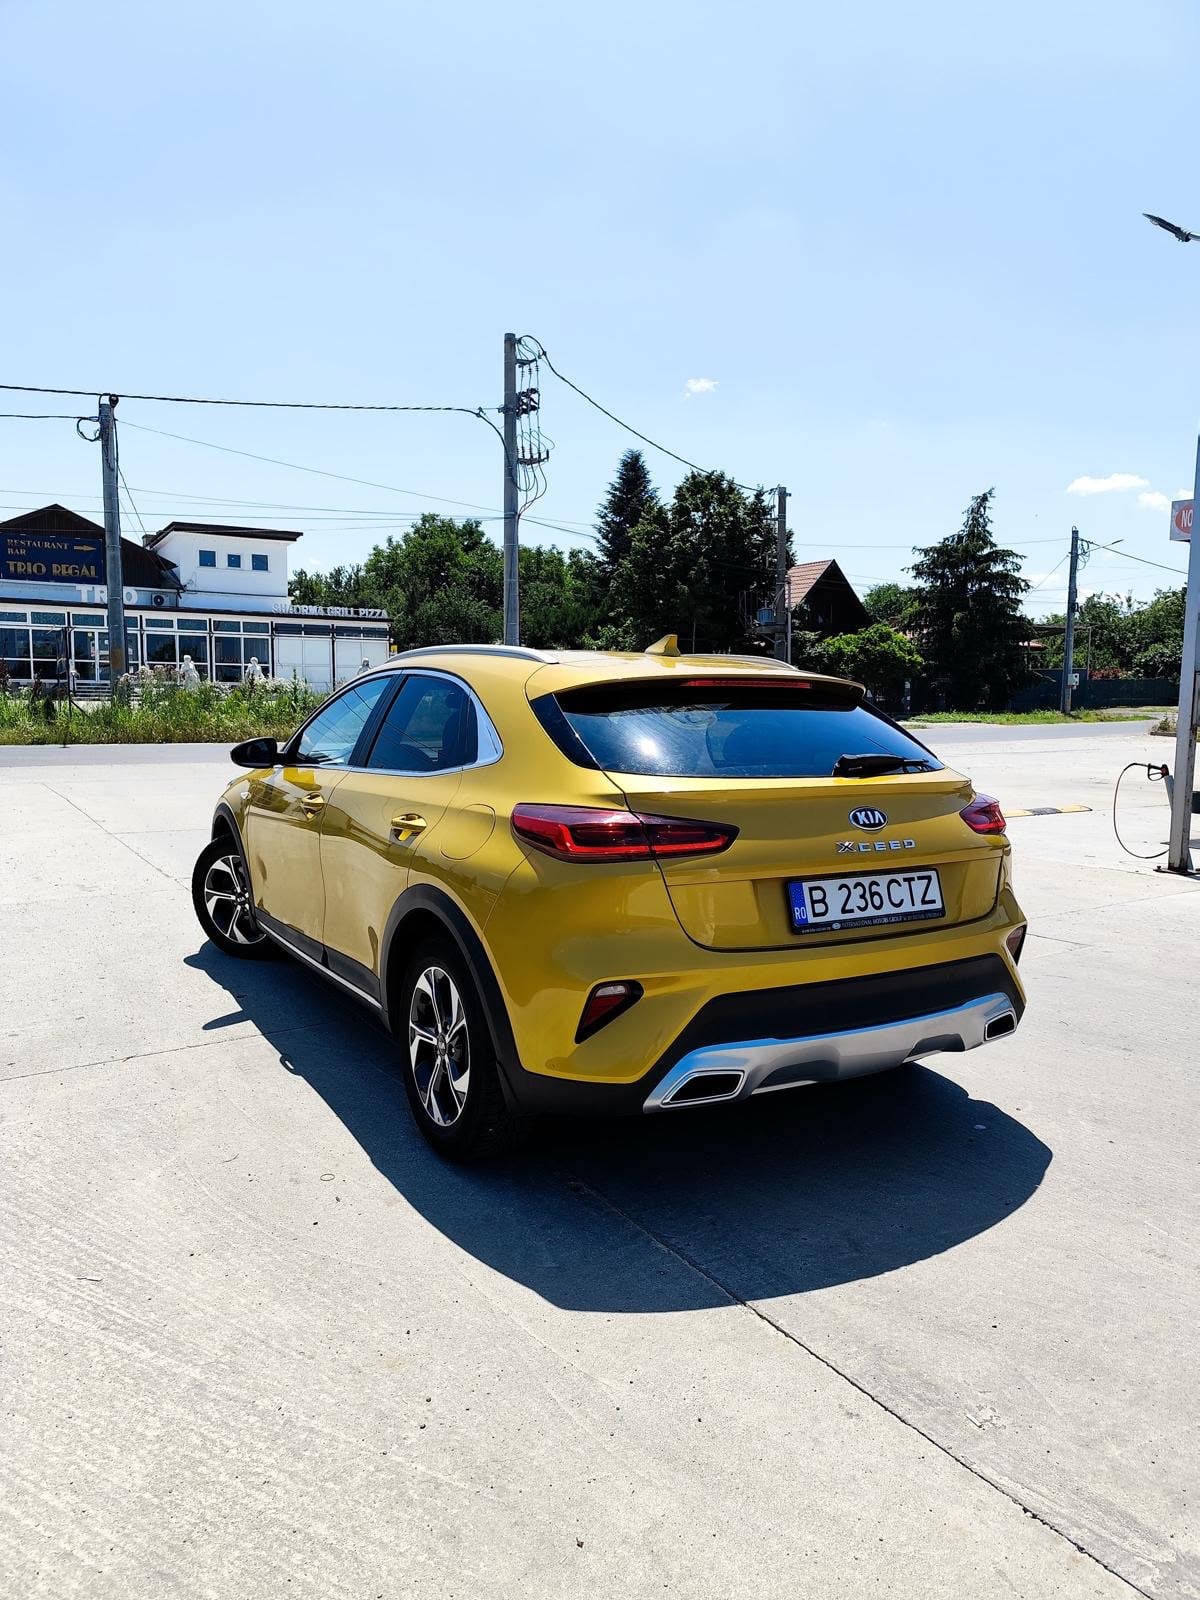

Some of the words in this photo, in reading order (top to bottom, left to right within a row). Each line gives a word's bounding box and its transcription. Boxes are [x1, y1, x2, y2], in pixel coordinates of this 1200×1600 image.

[7, 539, 69, 550] RESTAURANT
[7, 548, 26, 556] BAR
[6, 561, 46, 576] TRIO
[52, 563, 99, 578] REGAL
[76, 584, 138, 605] TRO
[271, 603, 324, 616] SHAORMA
[327, 606, 355, 617] GRILL
[360, 608, 389, 619] PIZZA
[856, 810, 885, 825] KIA
[836, 839, 916, 853] XCEED
[808, 885, 829, 918] B
[794, 907, 807, 920] RO
